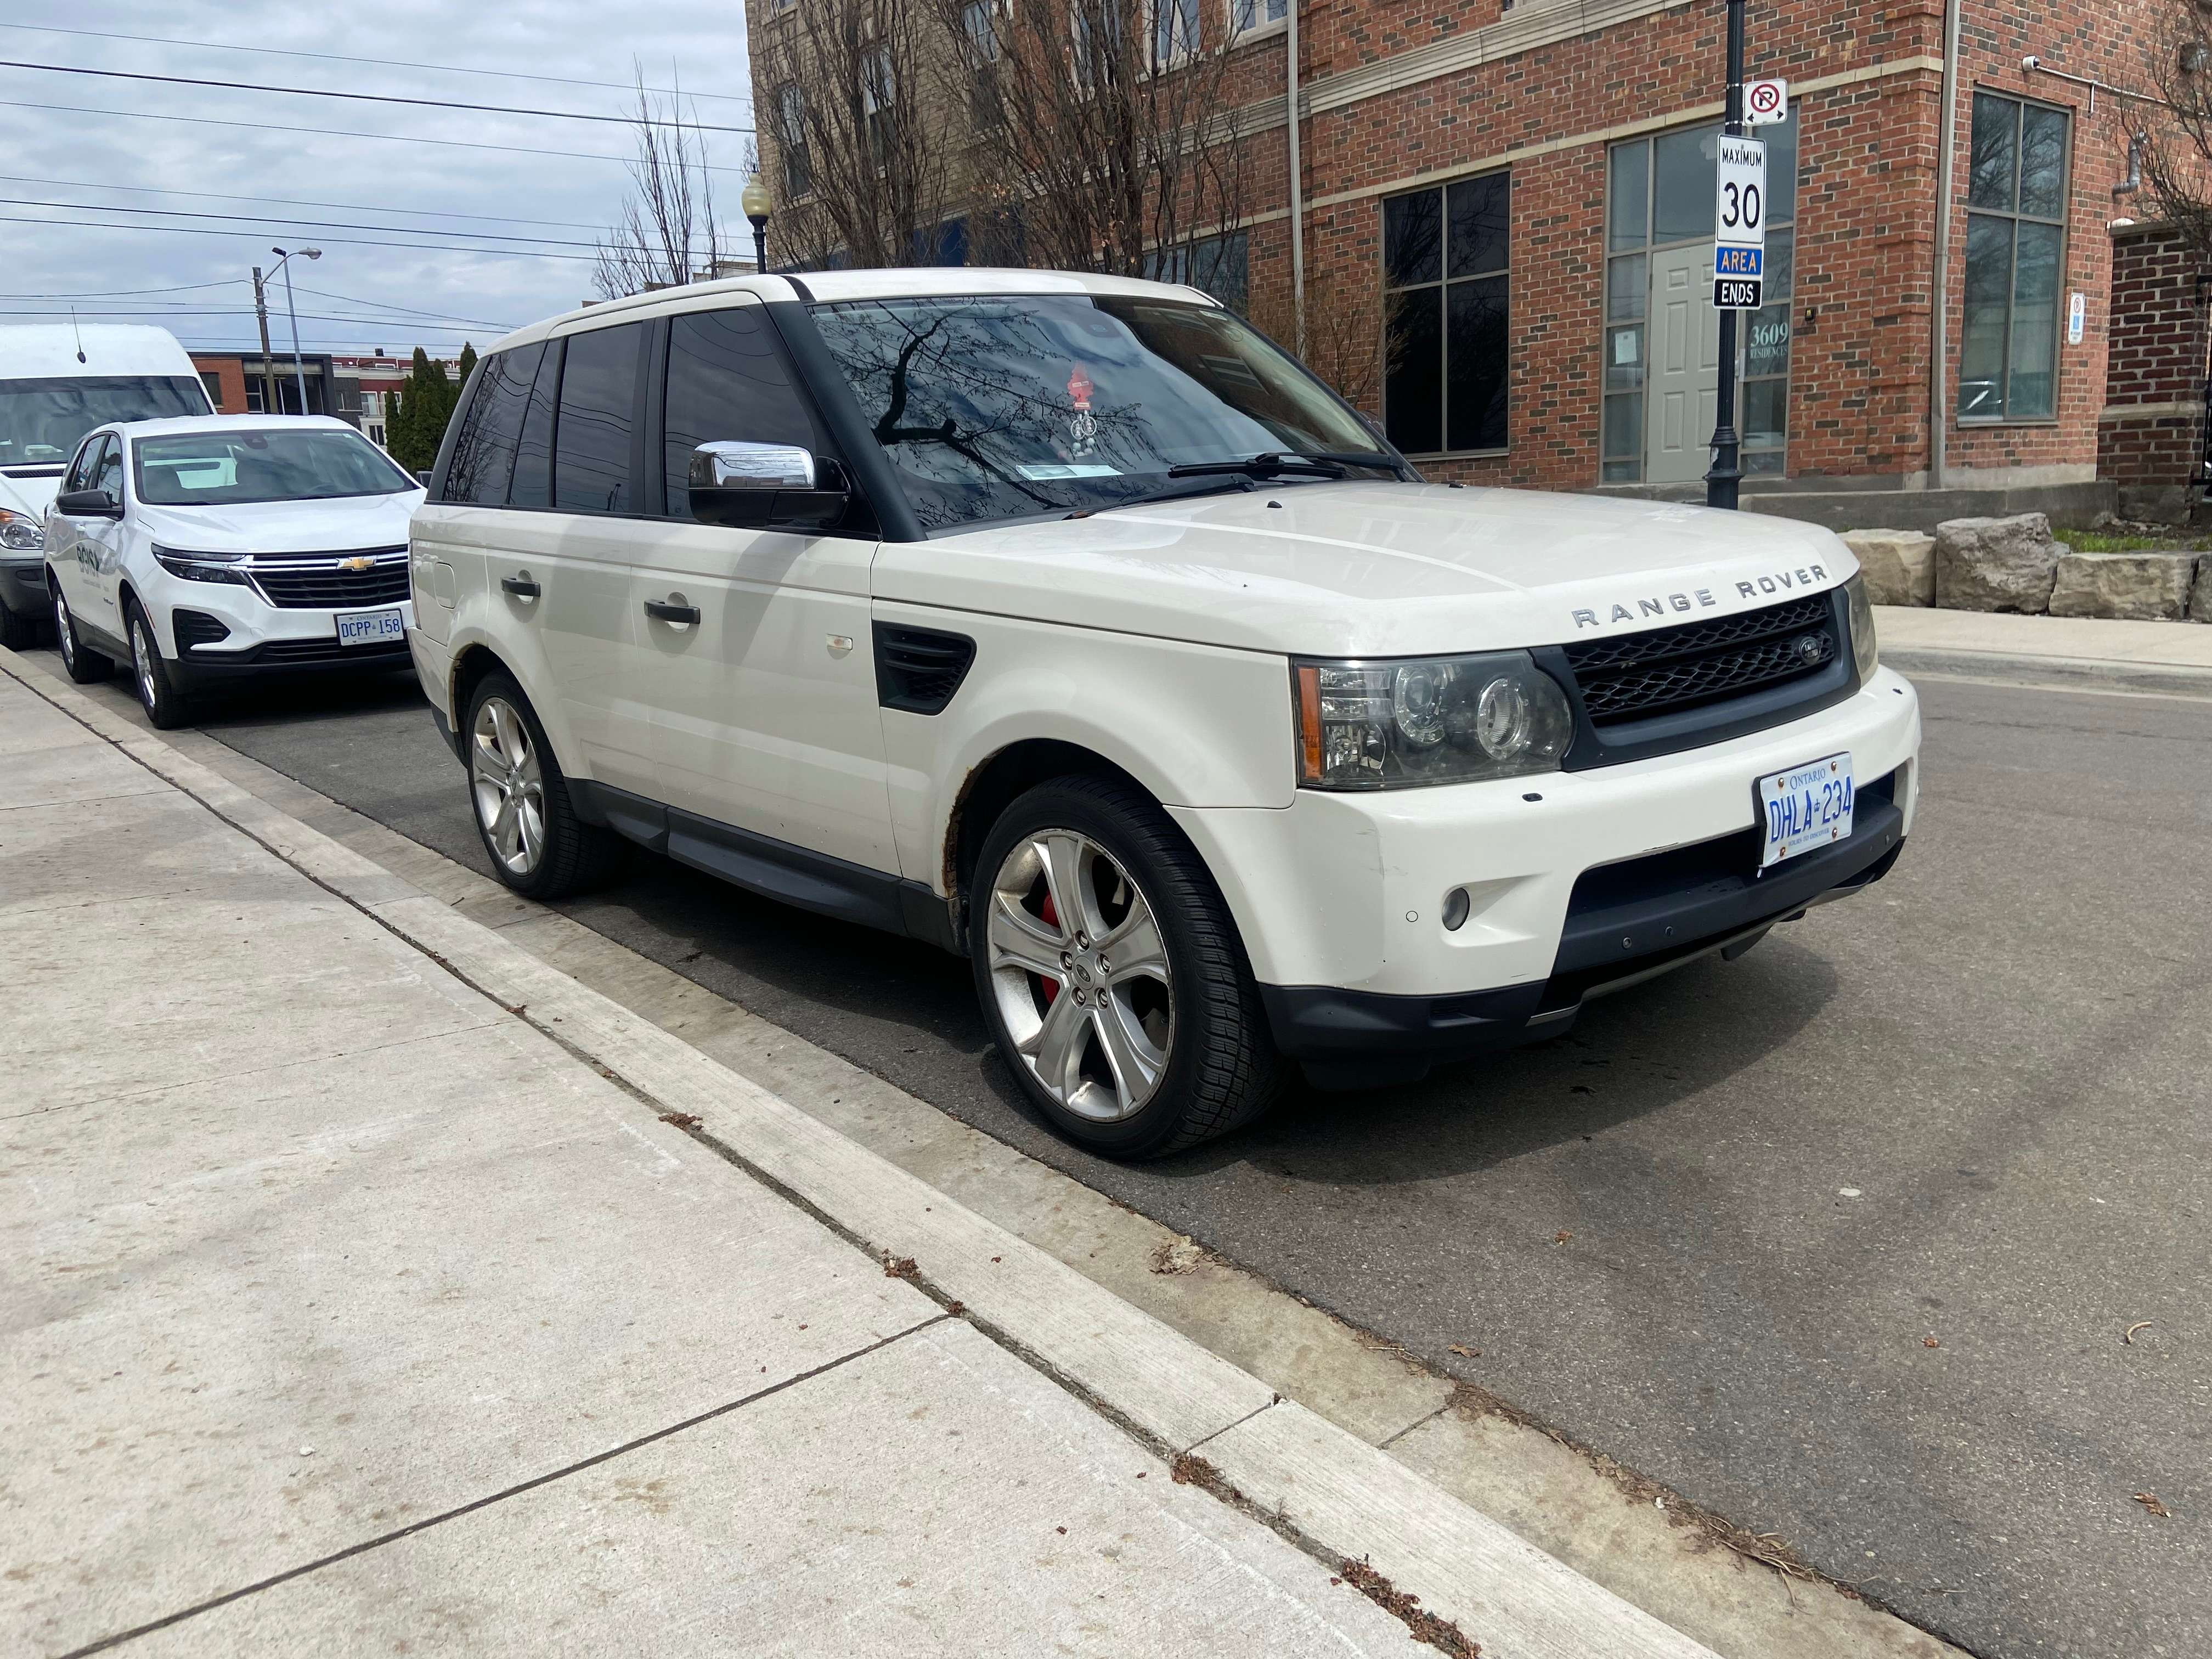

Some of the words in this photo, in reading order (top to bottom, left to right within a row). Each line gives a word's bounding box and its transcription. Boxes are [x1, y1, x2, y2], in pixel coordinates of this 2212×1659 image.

[1722, 148, 1762, 167] MAXIMUM
[1722, 182, 1760, 229] 30
[1721, 251, 1756, 272] AREA
[1721, 283, 1753, 304] ENDS
[1750, 322, 1788, 347] 3609
[1750, 346, 1787, 359] RESIDENCES
[1571, 589, 1716, 628] RANGE
[1735, 565, 1827, 598] ROVER
[341, 621, 371, 637] DCPP
[379, 618, 400, 634] 158
[1790, 768, 1826, 790] ONTARIO
[1769, 789, 1812, 843] DHLA
[1821, 775, 1852, 825] 234
